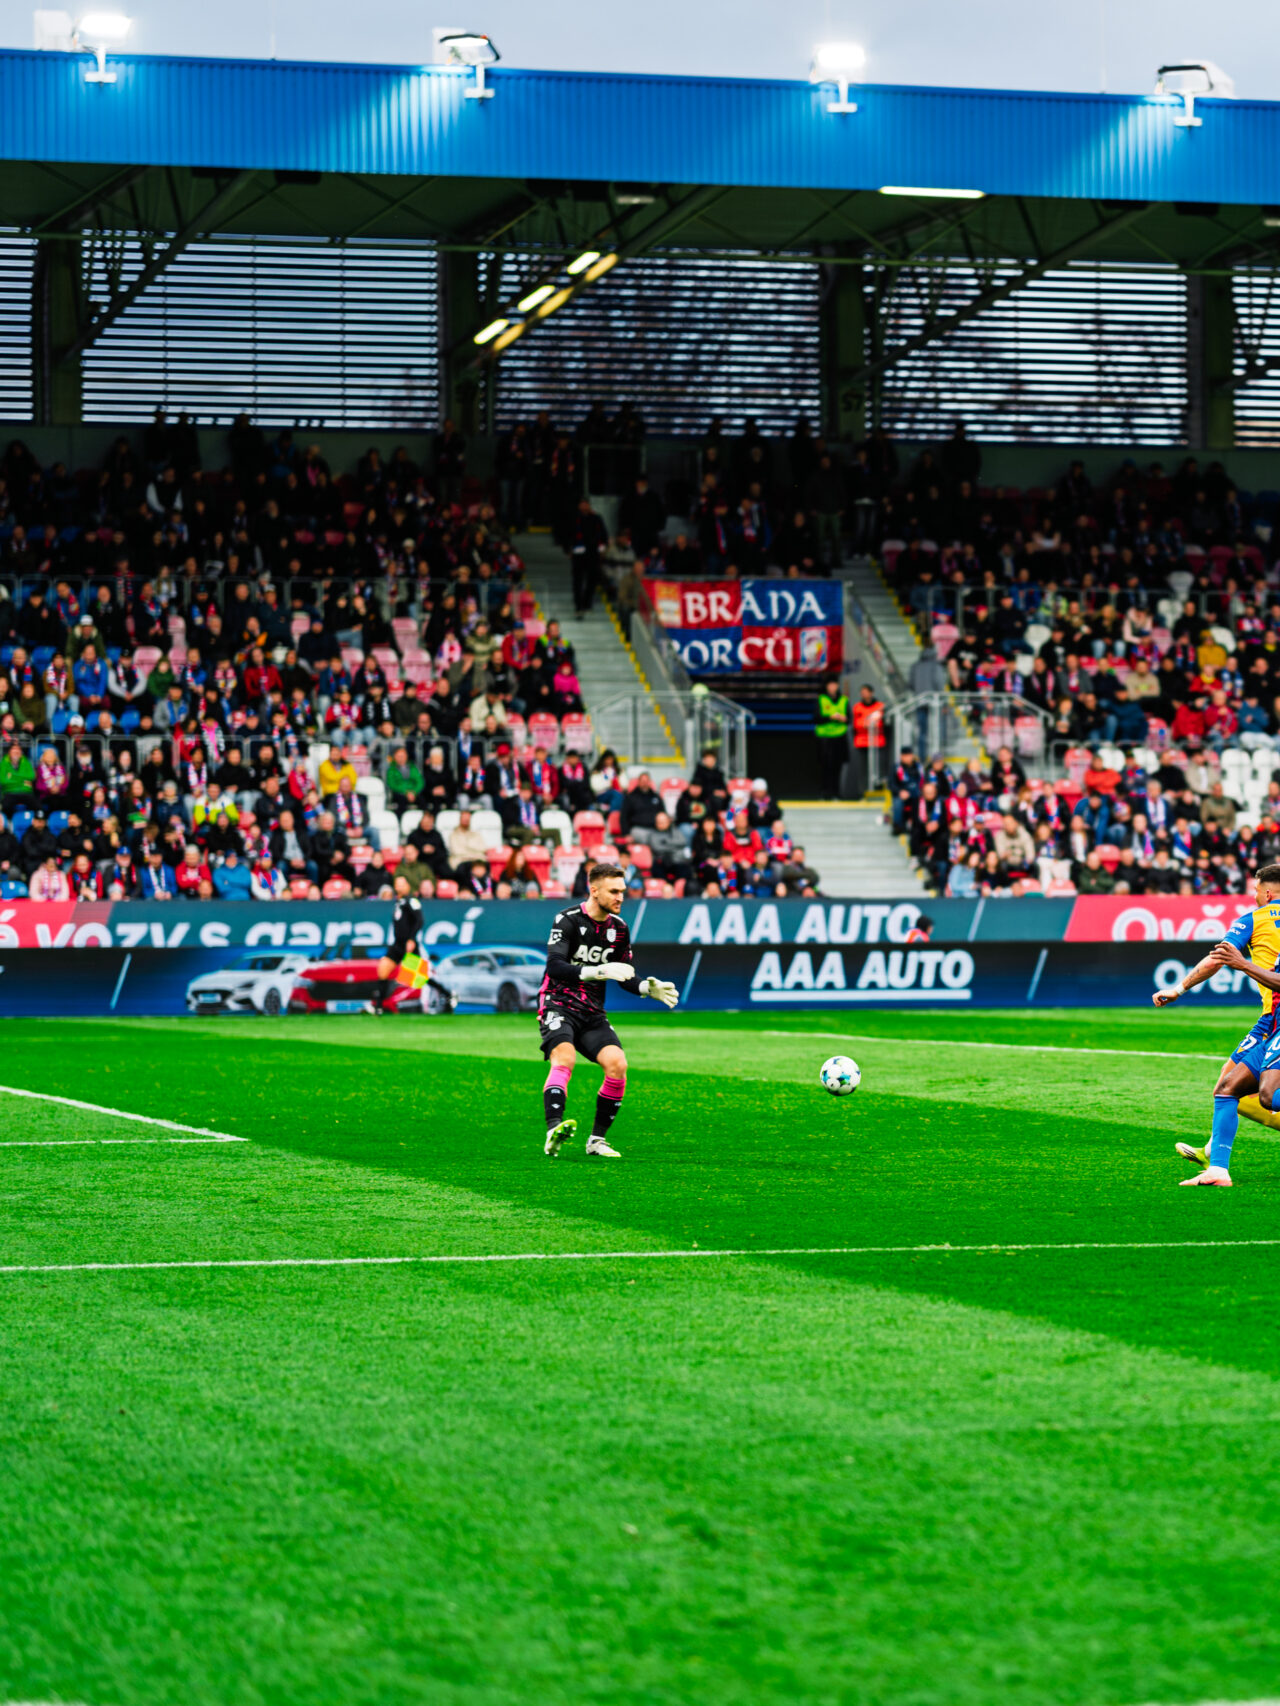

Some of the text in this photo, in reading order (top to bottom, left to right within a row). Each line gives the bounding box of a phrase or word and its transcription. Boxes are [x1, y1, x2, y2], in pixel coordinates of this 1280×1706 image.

[684, 582, 826, 625] BRÁNA
[200, 922, 231, 947] s
[245, 906, 483, 947] arací
[679, 904, 921, 943] AAA AUTO
[574, 944, 615, 964] AGC
[751, 950, 975, 989] AAA AUTO
